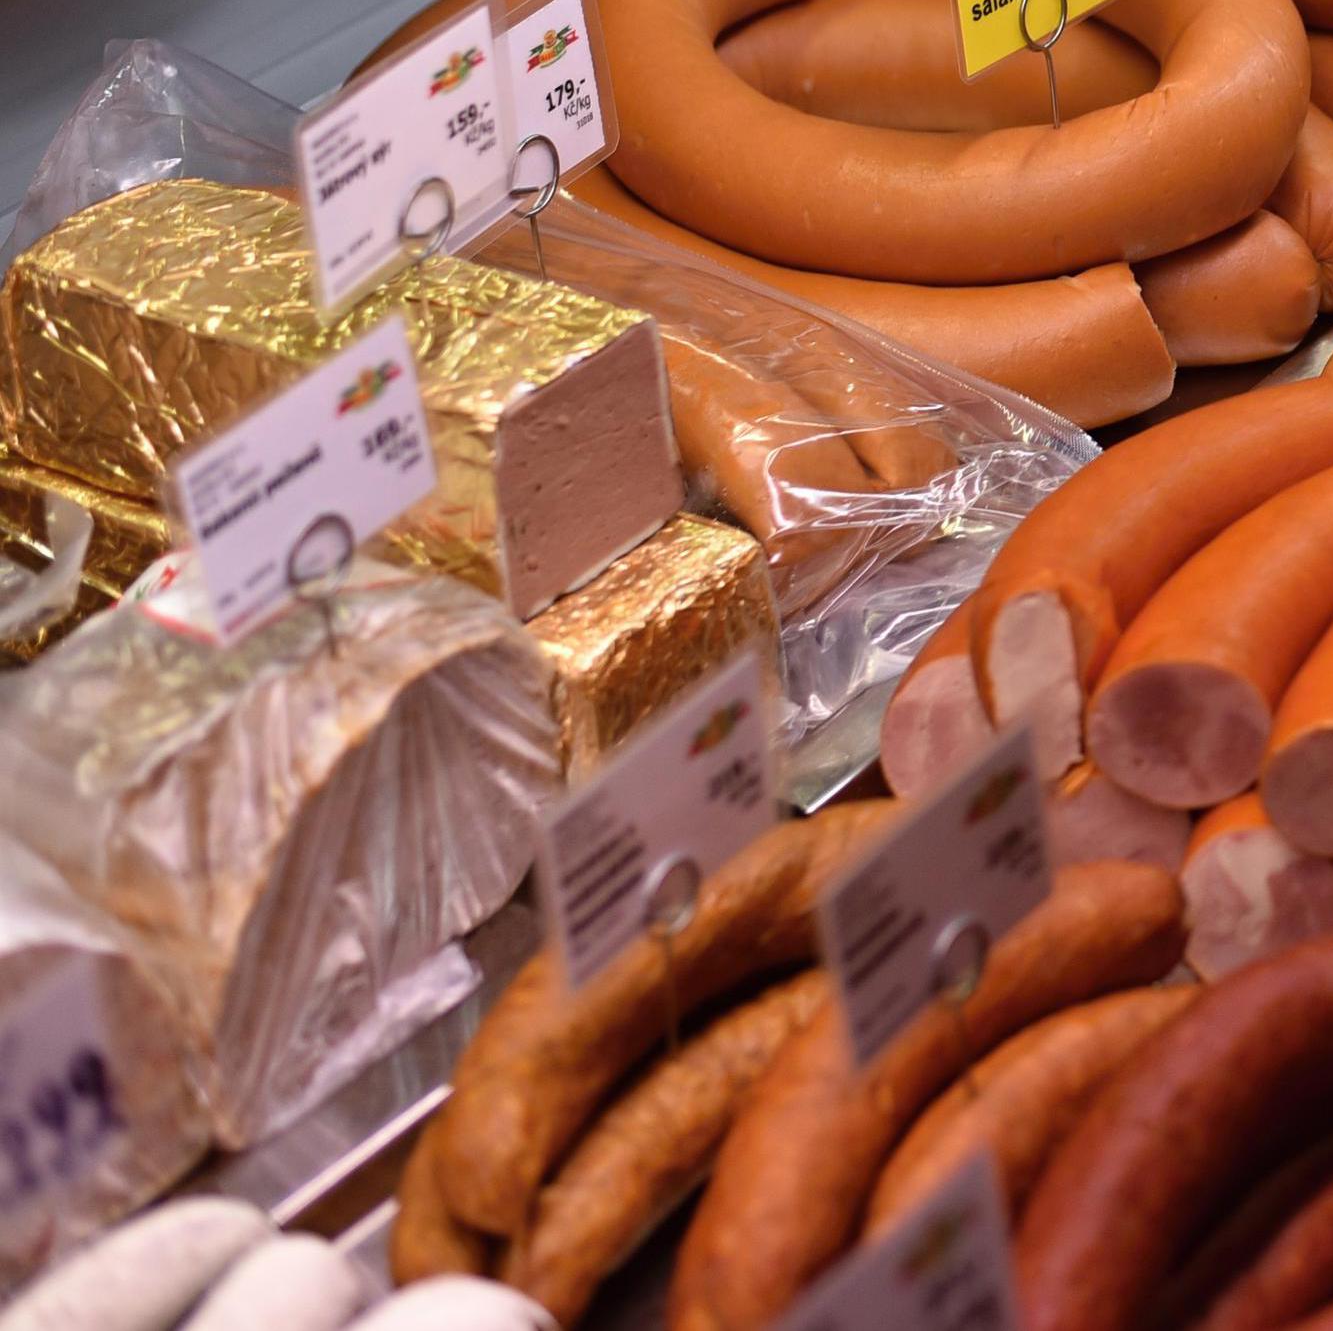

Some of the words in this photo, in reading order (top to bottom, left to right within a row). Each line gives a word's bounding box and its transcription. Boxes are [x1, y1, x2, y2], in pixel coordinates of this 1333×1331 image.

[545, 76, 587, 113] 179,-
[563, 94, 592, 122] Kč/kg
[446, 99, 492, 140] 159,-
